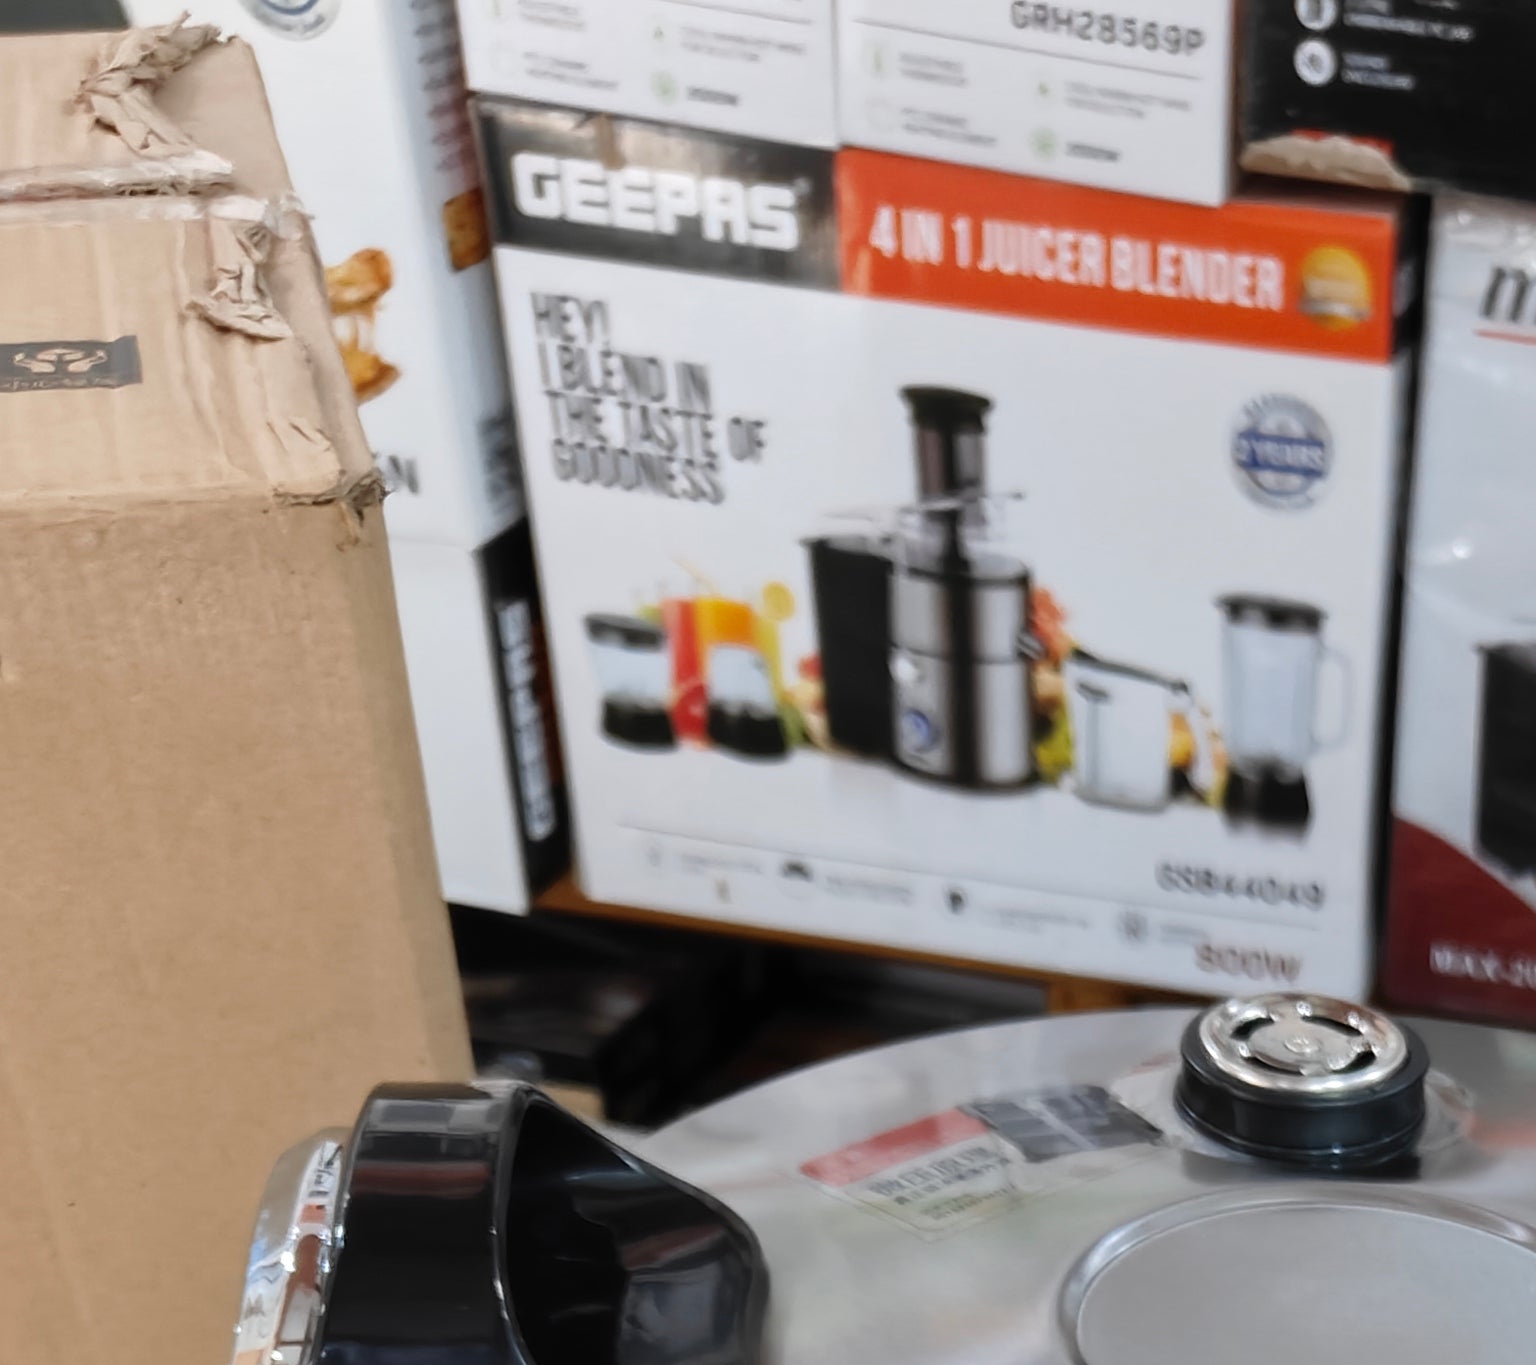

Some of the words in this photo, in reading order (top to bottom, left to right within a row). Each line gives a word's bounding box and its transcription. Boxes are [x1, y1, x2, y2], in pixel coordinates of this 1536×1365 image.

[511, 153, 799, 250] GEEPAS
[977, 219, 1107, 287] JUICER
[1111, 232, 1285, 313] BLENDER
